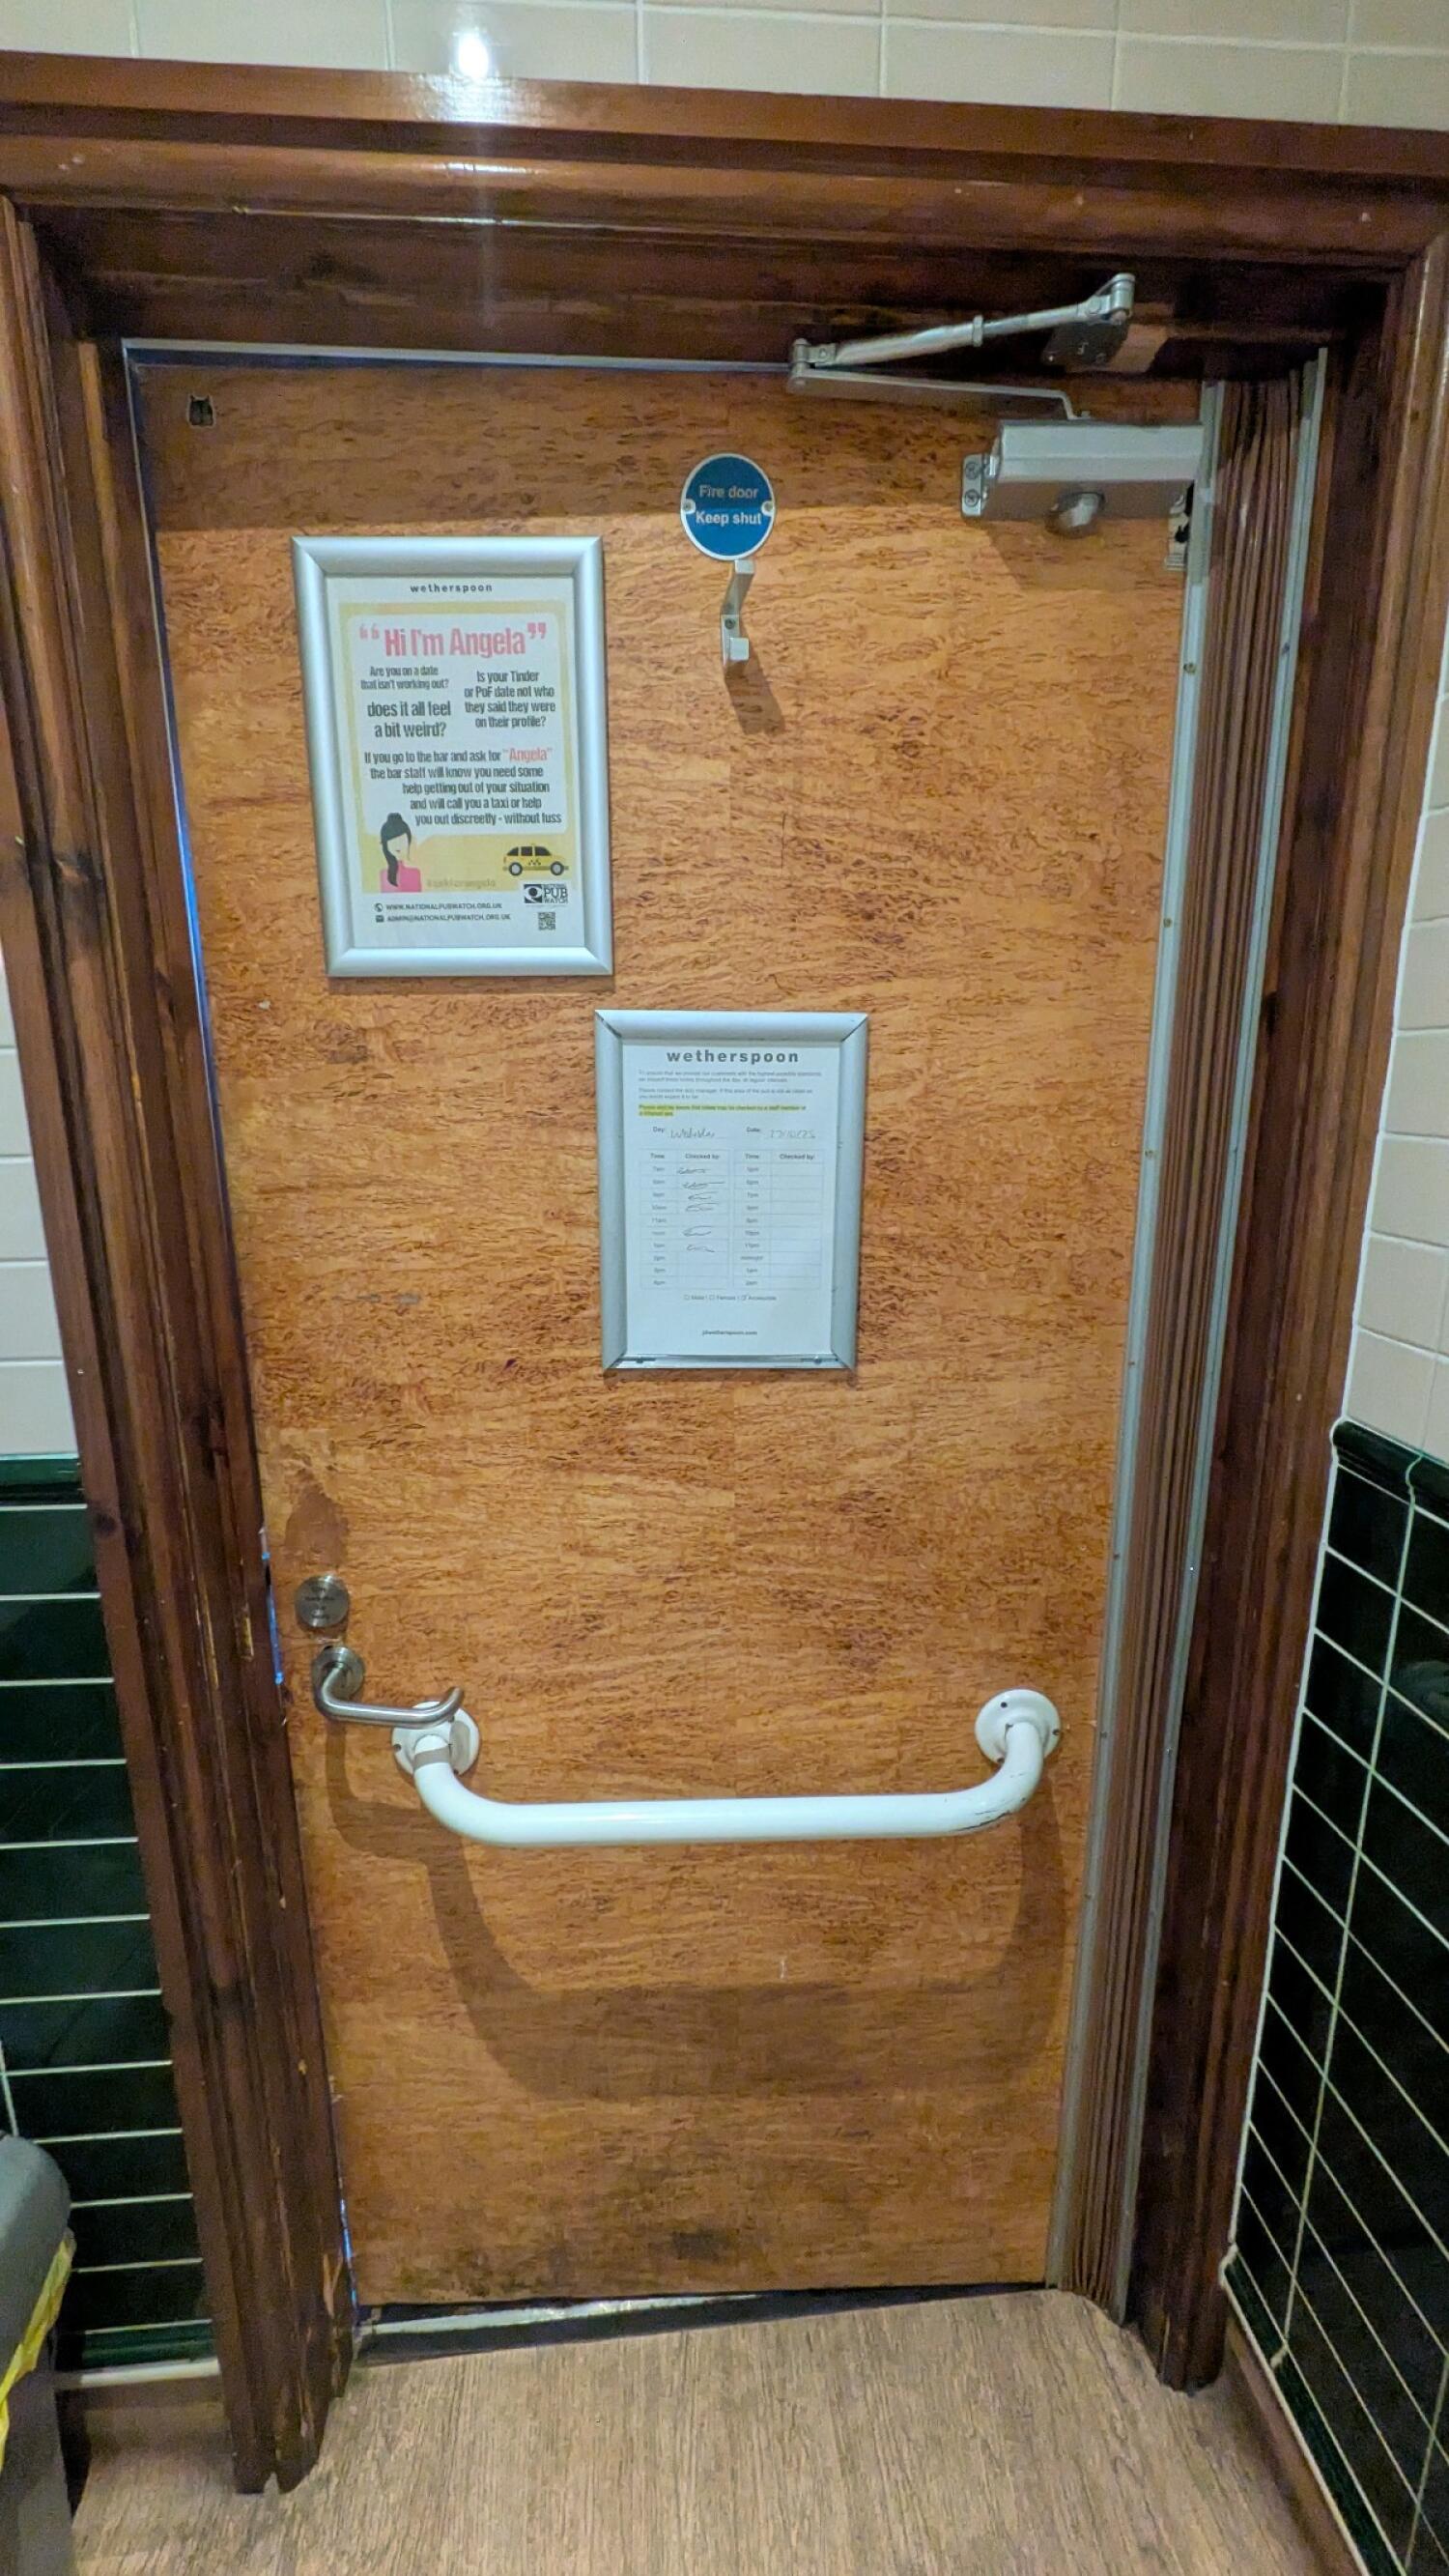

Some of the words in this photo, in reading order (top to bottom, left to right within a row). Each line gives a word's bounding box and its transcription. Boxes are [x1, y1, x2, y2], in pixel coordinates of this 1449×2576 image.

[698, 484, 724, 498] Fire
[728, 485, 759, 499] door
[696, 510, 729, 528] Keep
[732, 512, 761, 525] shut
[410, 584, 493, 593] wetherspoon
[411, 628, 444, 656] I'm
[370, 666, 384, 676] Are
[386, 667, 401, 677] you
[402, 667, 412, 676] on
[413, 667, 419, 675] a
[420, 666, 439, 675] date
[476, 671, 485, 682] Is
[487, 672, 508, 684] your
[510, 670, 539, 682] Tinder
[360, 679, 377, 690] that
[378, 679, 394, 690] isn't
[396, 679, 430, 690] working
[431, 678, 449, 689] out?
[464, 687, 473, 698] or
[494, 686, 515, 697] date
[517, 686, 531, 697] not
[533, 686, 554, 697] who
[367, 701, 398, 717] does
[400, 701, 408, 716] it
[412, 701, 425, 716] all
[428, 701, 451, 716] feel
[465, 701, 484, 714] they
[487, 701, 507, 712] said
[508, 701, 528, 713] they
[530, 701, 555, 712] were
[374, 724, 383, 737] a
[384, 723, 401, 737] bit
[403, 721, 446, 737] weird?
[475, 717, 487, 728] on
[488, 716, 509, 728] their
[511, 715, 547, 729] profile?
[364, 752, 371, 763] If
[373, 753, 390, 764] you
[392, 752, 404, 764] go
[406, 751, 415, 762] to
[416, 751, 432, 762] the
[434, 751, 448, 762] bar
[451, 750, 468, 762] and
[469, 750, 486, 761] ask
[488, 750, 501, 761] for
[371, 768, 385, 779] the
[386, 768, 402, 779] bar
[404, 767, 425, 778] staff
[428, 766, 443, 778] will
[445, 766, 471, 778] know
[473, 767, 492, 779] you
[494, 765, 516, 777] need
[518, 767, 543, 777] some
[402, 783, 422, 794] help
[424, 783, 457, 794] getting
[458, 782, 473, 792] out
[474, 782, 484, 792] of
[486, 783, 507, 794] your
[509, 782, 550, 792] situation
[411, 799, 426, 809] and
[428, 798, 444, 809] will
[446, 798, 463, 809] call
[465, 798, 481, 810] you
[483, 799, 490, 808] a
[491, 797, 509, 808] taxi
[511, 799, 520, 809] or
[522, 797, 542, 809] help
[415, 815, 432, 826] you
[434, 814, 449, 824] out
[451, 813, 497, 825] discreetly
[504, 813, 540, 824] without
[542, 813, 562, 823] fuss
[544, 888, 568, 899] PUB
[667, 1049, 799, 1065] wetherspoon
